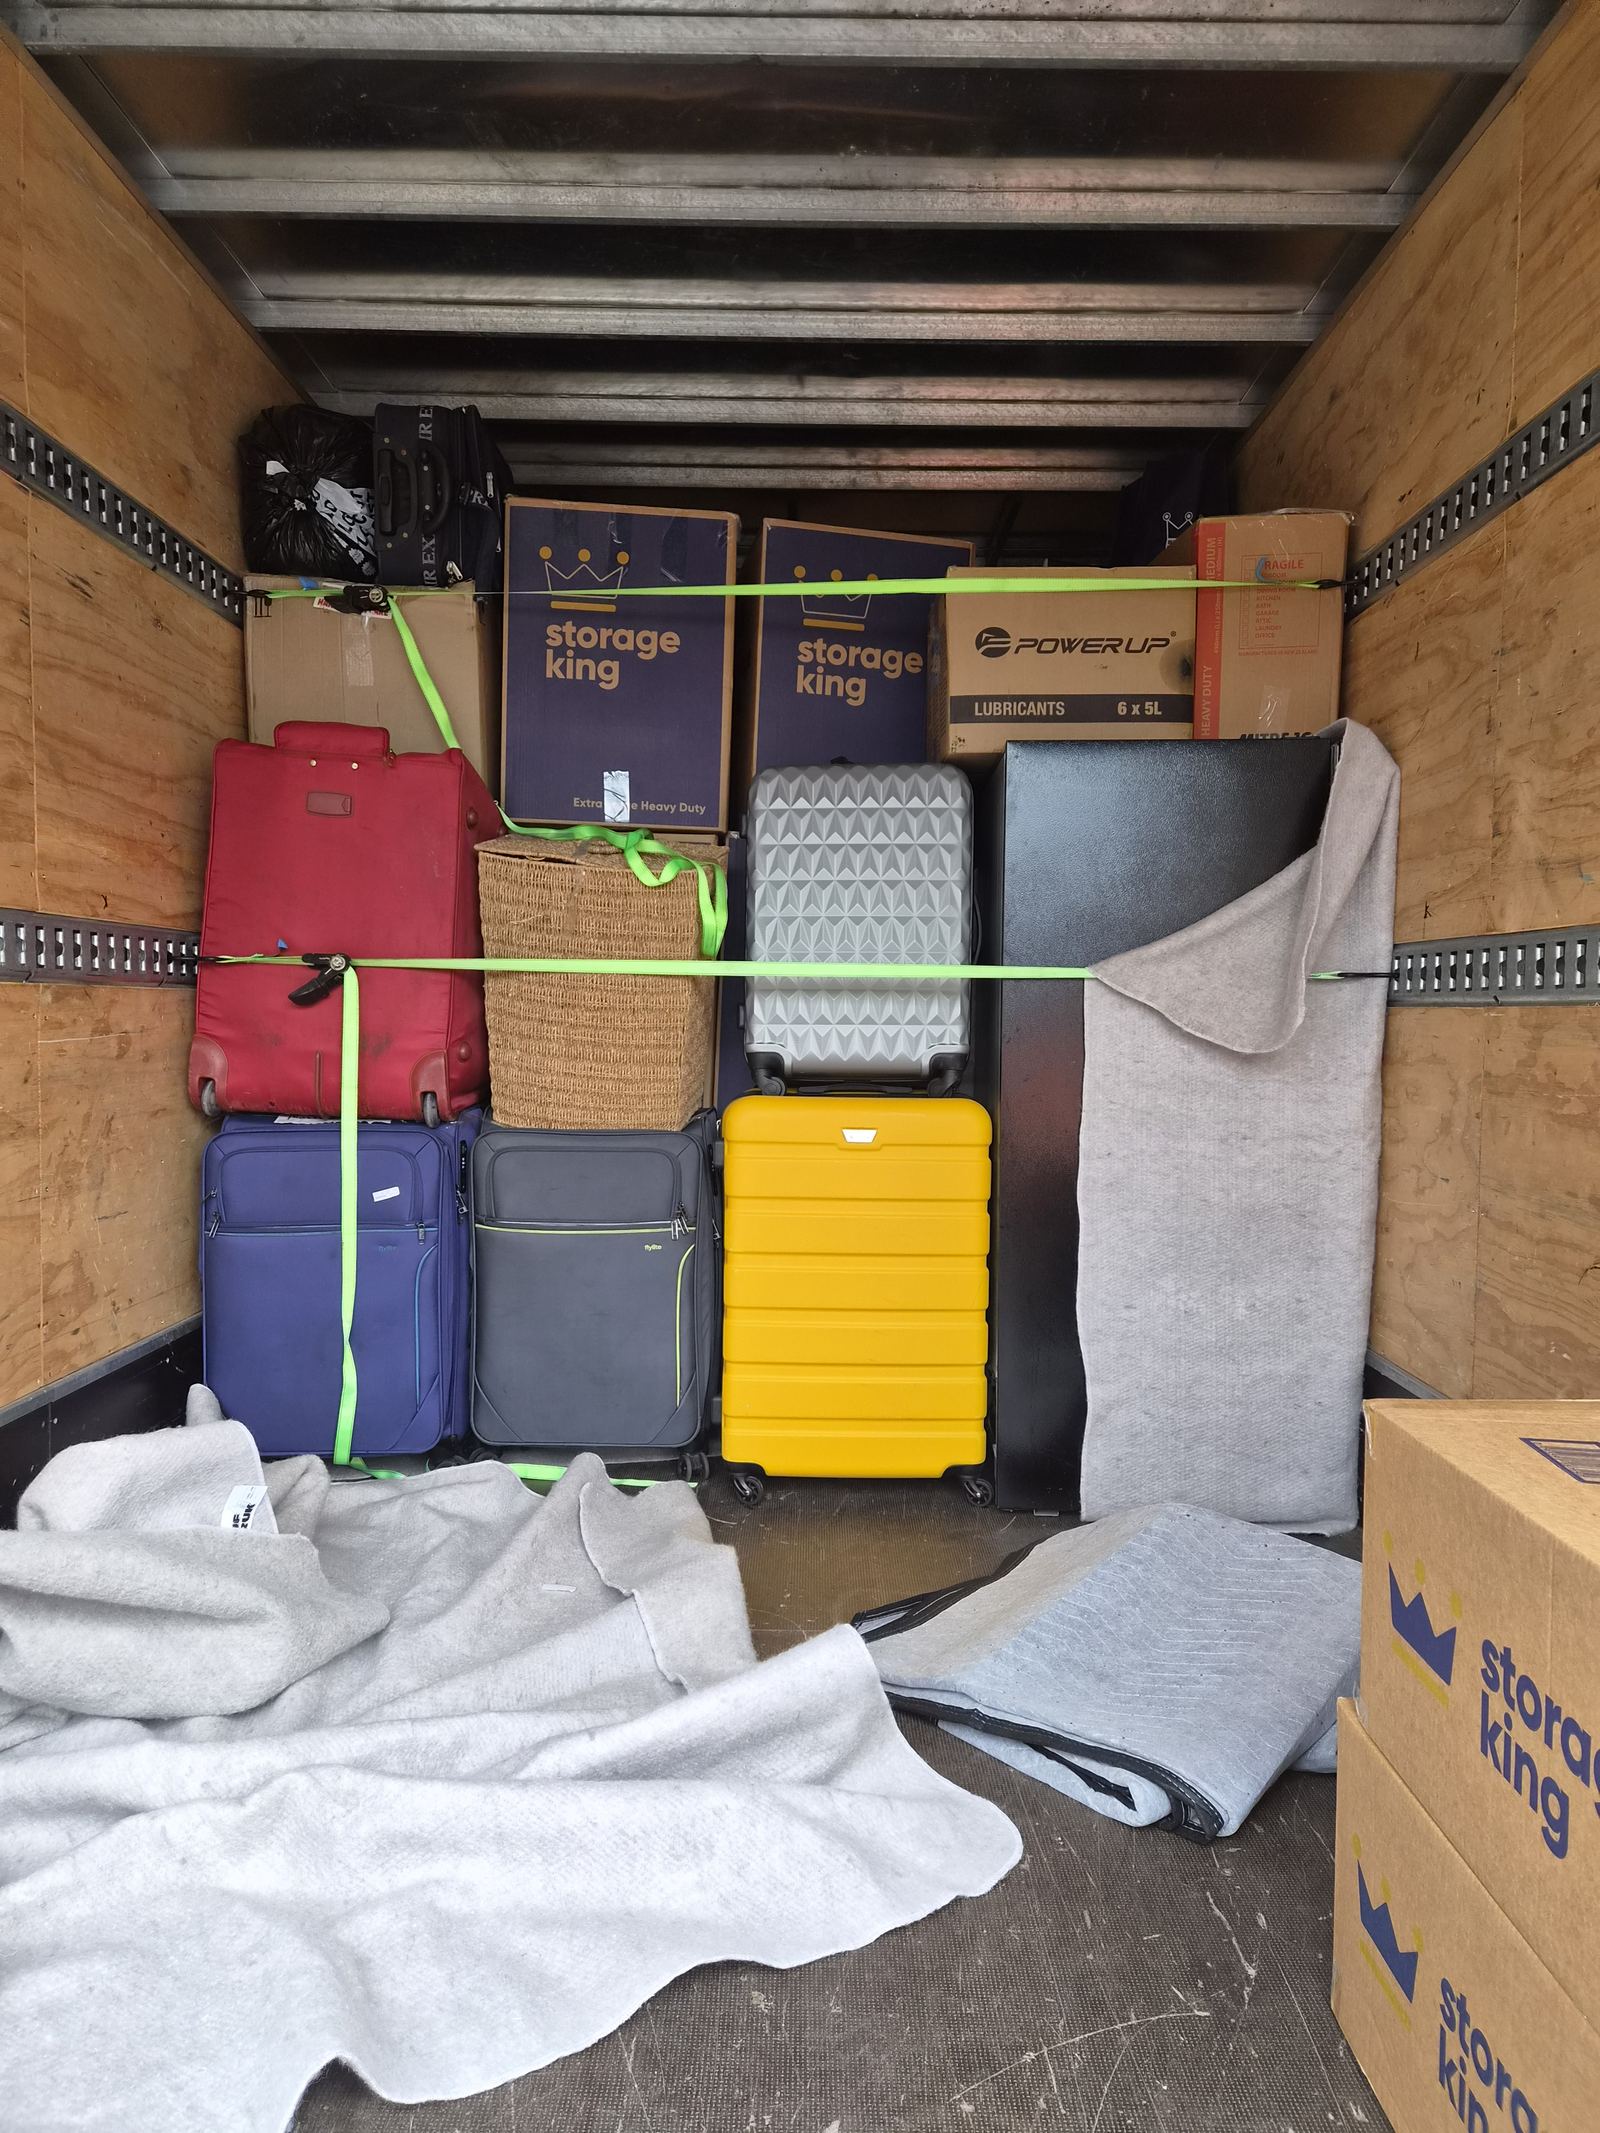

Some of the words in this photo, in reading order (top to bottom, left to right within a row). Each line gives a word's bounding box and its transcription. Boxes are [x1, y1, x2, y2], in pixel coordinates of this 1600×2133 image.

[1258, 559, 1305, 570] RAGILE
[545, 620, 681, 661] storage
[797, 638, 923, 679] storage
[545, 649, 620, 690] king
[796, 665, 867, 707] king
[1202, 665, 1213, 697] DUTY
[974, 701, 1065, 716] LUBRICANTS
[1117, 701, 1127, 716] 6
[1131, 703, 1140, 715] x
[1144, 701, 1162, 716] 5L
[1201, 700, 1212, 736] HEAVY
[573, 797, 602, 808] Extra
[641, 801, 676, 814] Heavy
[679, 802, 707, 815] Duty
[1481, 1639, 1600, 1828] stora
[1480, 1689, 1569, 1860] king
